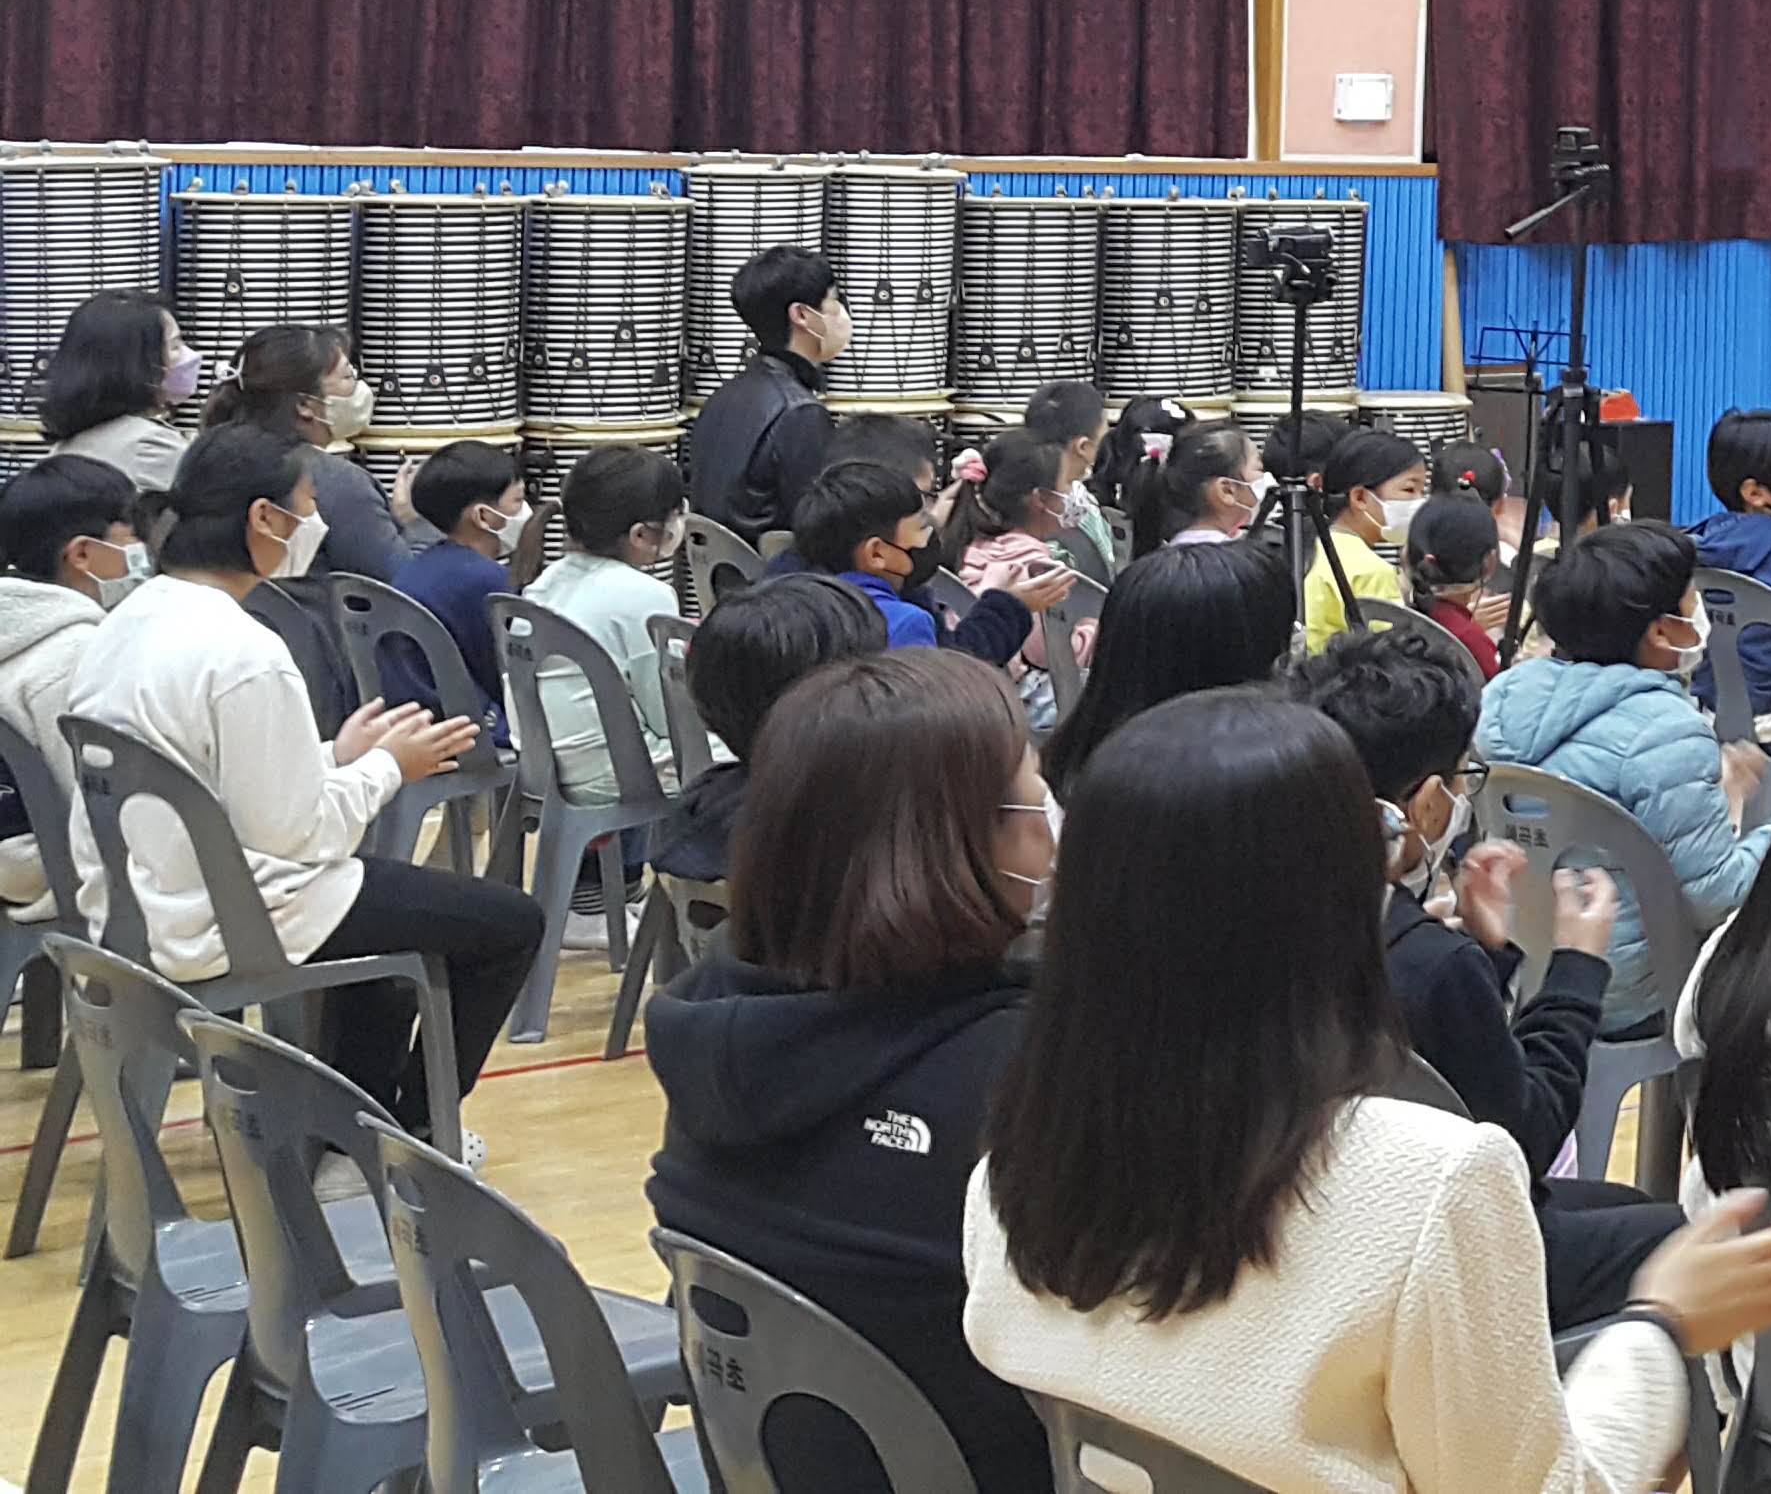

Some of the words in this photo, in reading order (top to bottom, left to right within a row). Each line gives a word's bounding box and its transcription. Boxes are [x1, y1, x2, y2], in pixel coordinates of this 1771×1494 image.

[863, 1116, 909, 1137] NORTH
[886, 1109, 911, 1126] THE
[871, 1132, 912, 1151] FACE
